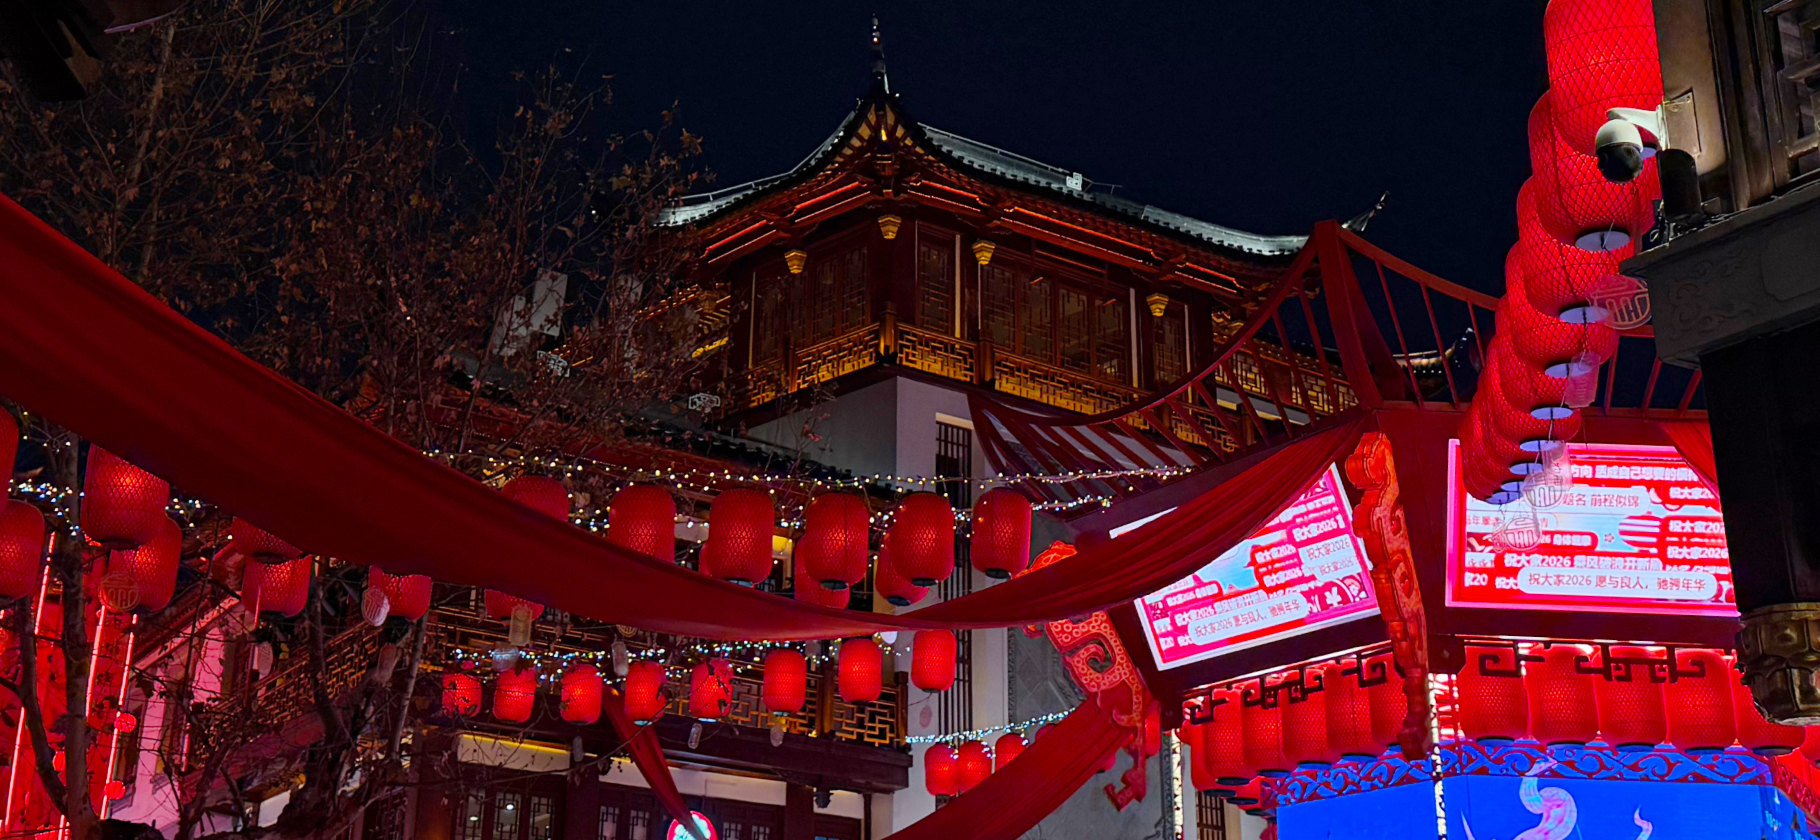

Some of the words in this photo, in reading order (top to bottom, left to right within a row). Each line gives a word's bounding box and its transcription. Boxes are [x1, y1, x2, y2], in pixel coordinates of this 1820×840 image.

[1591, 494, 1639, 507] 前程似锦
[1306, 538, 1351, 561] 祝大家2026
[1667, 546, 1728, 559] 祝大家2026
[1504, 553, 1571, 568] 祝大家2026
[1529, 573, 1592, 587] 祝大家2026
[1194, 617, 1233, 638] 祝大家2026
